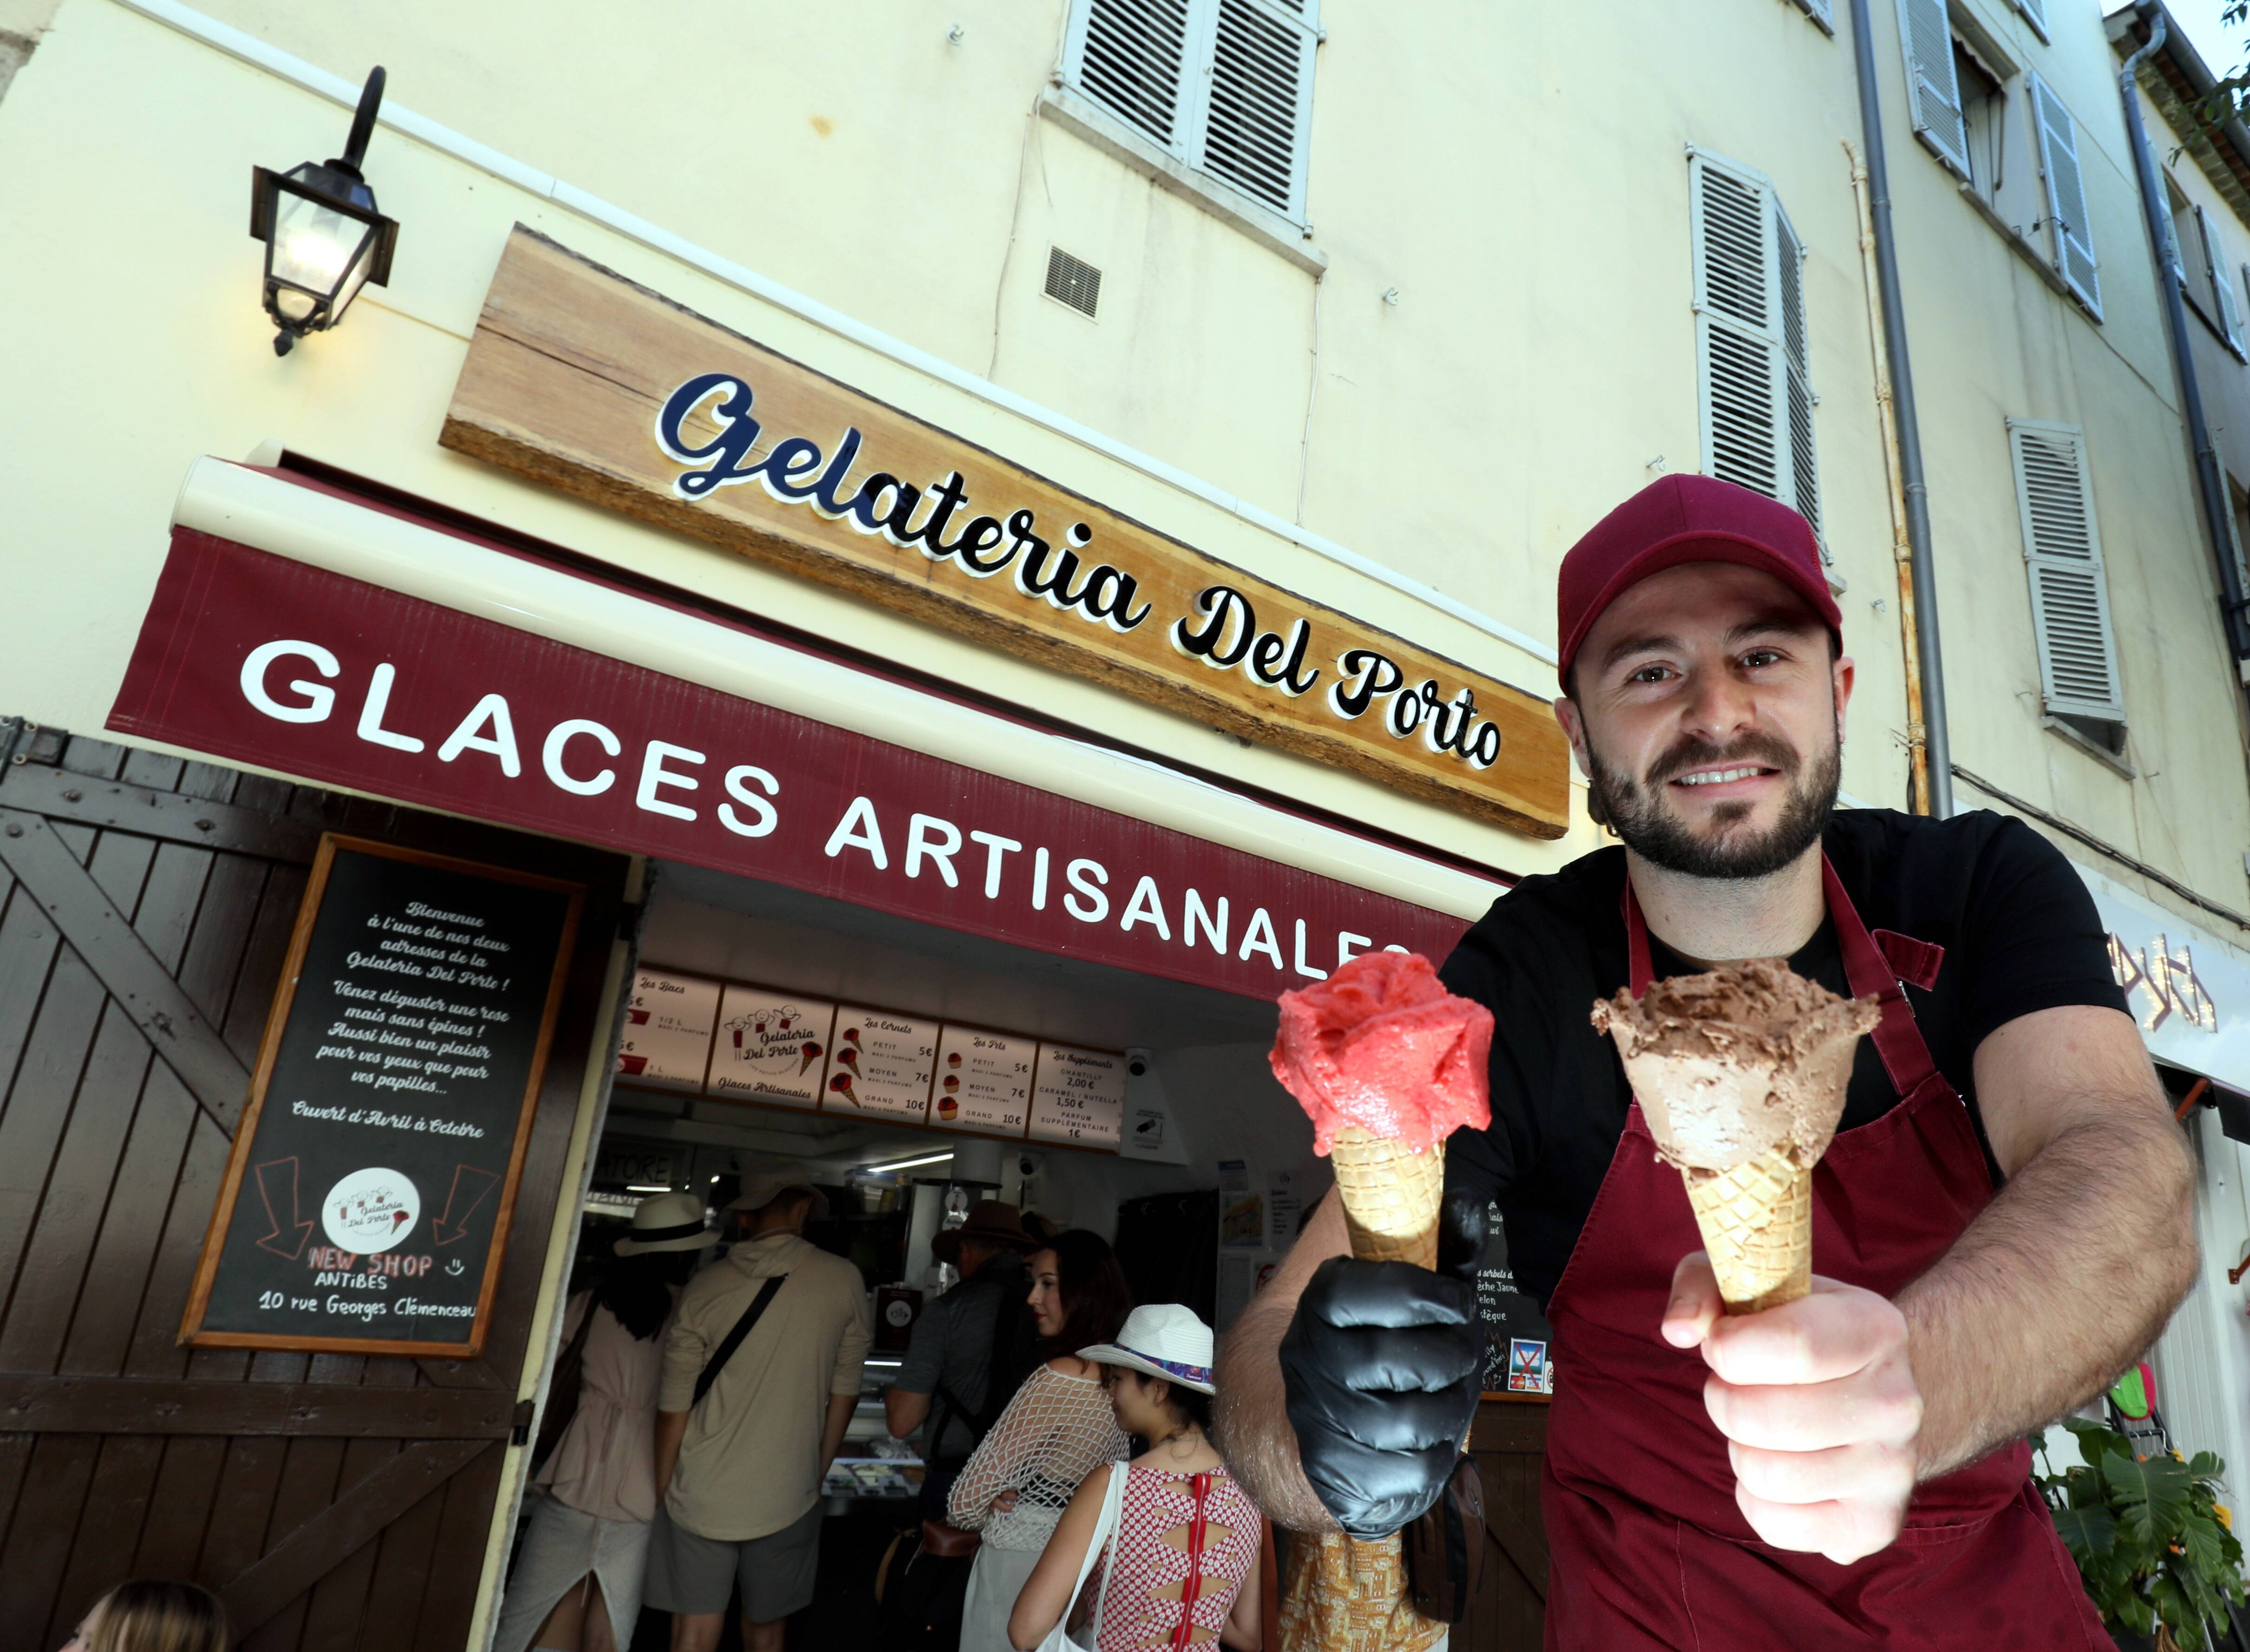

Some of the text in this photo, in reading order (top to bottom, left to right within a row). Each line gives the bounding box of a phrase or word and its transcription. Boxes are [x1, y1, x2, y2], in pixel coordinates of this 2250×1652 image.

[655, 373, 1501, 769] Gelateria Del Porto
[240, 639, 1411, 980] GLACES ARTISANALE
[406, 901, 485, 927] Bienvenue
[367, 915, 510, 951] à l'une de nos deux
[380, 939, 487, 967] adresses de la
[346, 951, 510, 991] Gelateria Del Porto !
[640, 977, 685, 994] Les Bacs
[334, 980, 510, 1023] Venez déguster une rose
[345, 1005, 485, 1038] mais sans épines !
[864, 1017, 912, 1034] Les Cornets
[328, 1022, 491, 1059] Aussi bien un plaisir
[760, 1029, 815, 1046] Gelateria
[873, 1042, 897, 1050] PETIT
[973, 1037, 985, 1047] Les
[743, 1045, 798, 1060] Del Porto
[1053, 1051, 1112, 1069] Les Suppléments
[316, 1045, 489, 1078] pour vos yeux que pour
[869, 1068, 897, 1077] MOYEN
[1061, 1069, 1102, 1080] CHANTILLY
[352, 1070, 447, 1094] vos papilles...
[718, 1077, 811, 1099] Glaces Artisanales
[970, 1084, 995, 1093] MOYEN
[1067, 1077, 1085, 1088] 2,00
[865, 1095, 893, 1104] GRAND
[1039, 1087, 1075, 1097] CARAMEL
[1084, 1094, 1117, 1104] NUTELLA
[1056, 1097, 1084, 1109] 1,50 €
[293, 1101, 484, 1138] Ouvert d'Avril à Octobre
[966, 1110, 992, 1119] GRAND
[1061, 1112, 1091, 1121] PARFUM
[1041, 1117, 1109, 1132] SUPPLÉMENTAIRE
[308, 1247, 433, 1278] NEW SHOP
[1483, 1269, 1506, 1278] sorbets
[1477, 1279, 1495, 1291] èche
[259, 1291, 476, 1321] 10 rue Georges Clémenceau
[1478, 1294, 1496, 1305] elon
[1480, 1309, 1507, 1323] stèque
